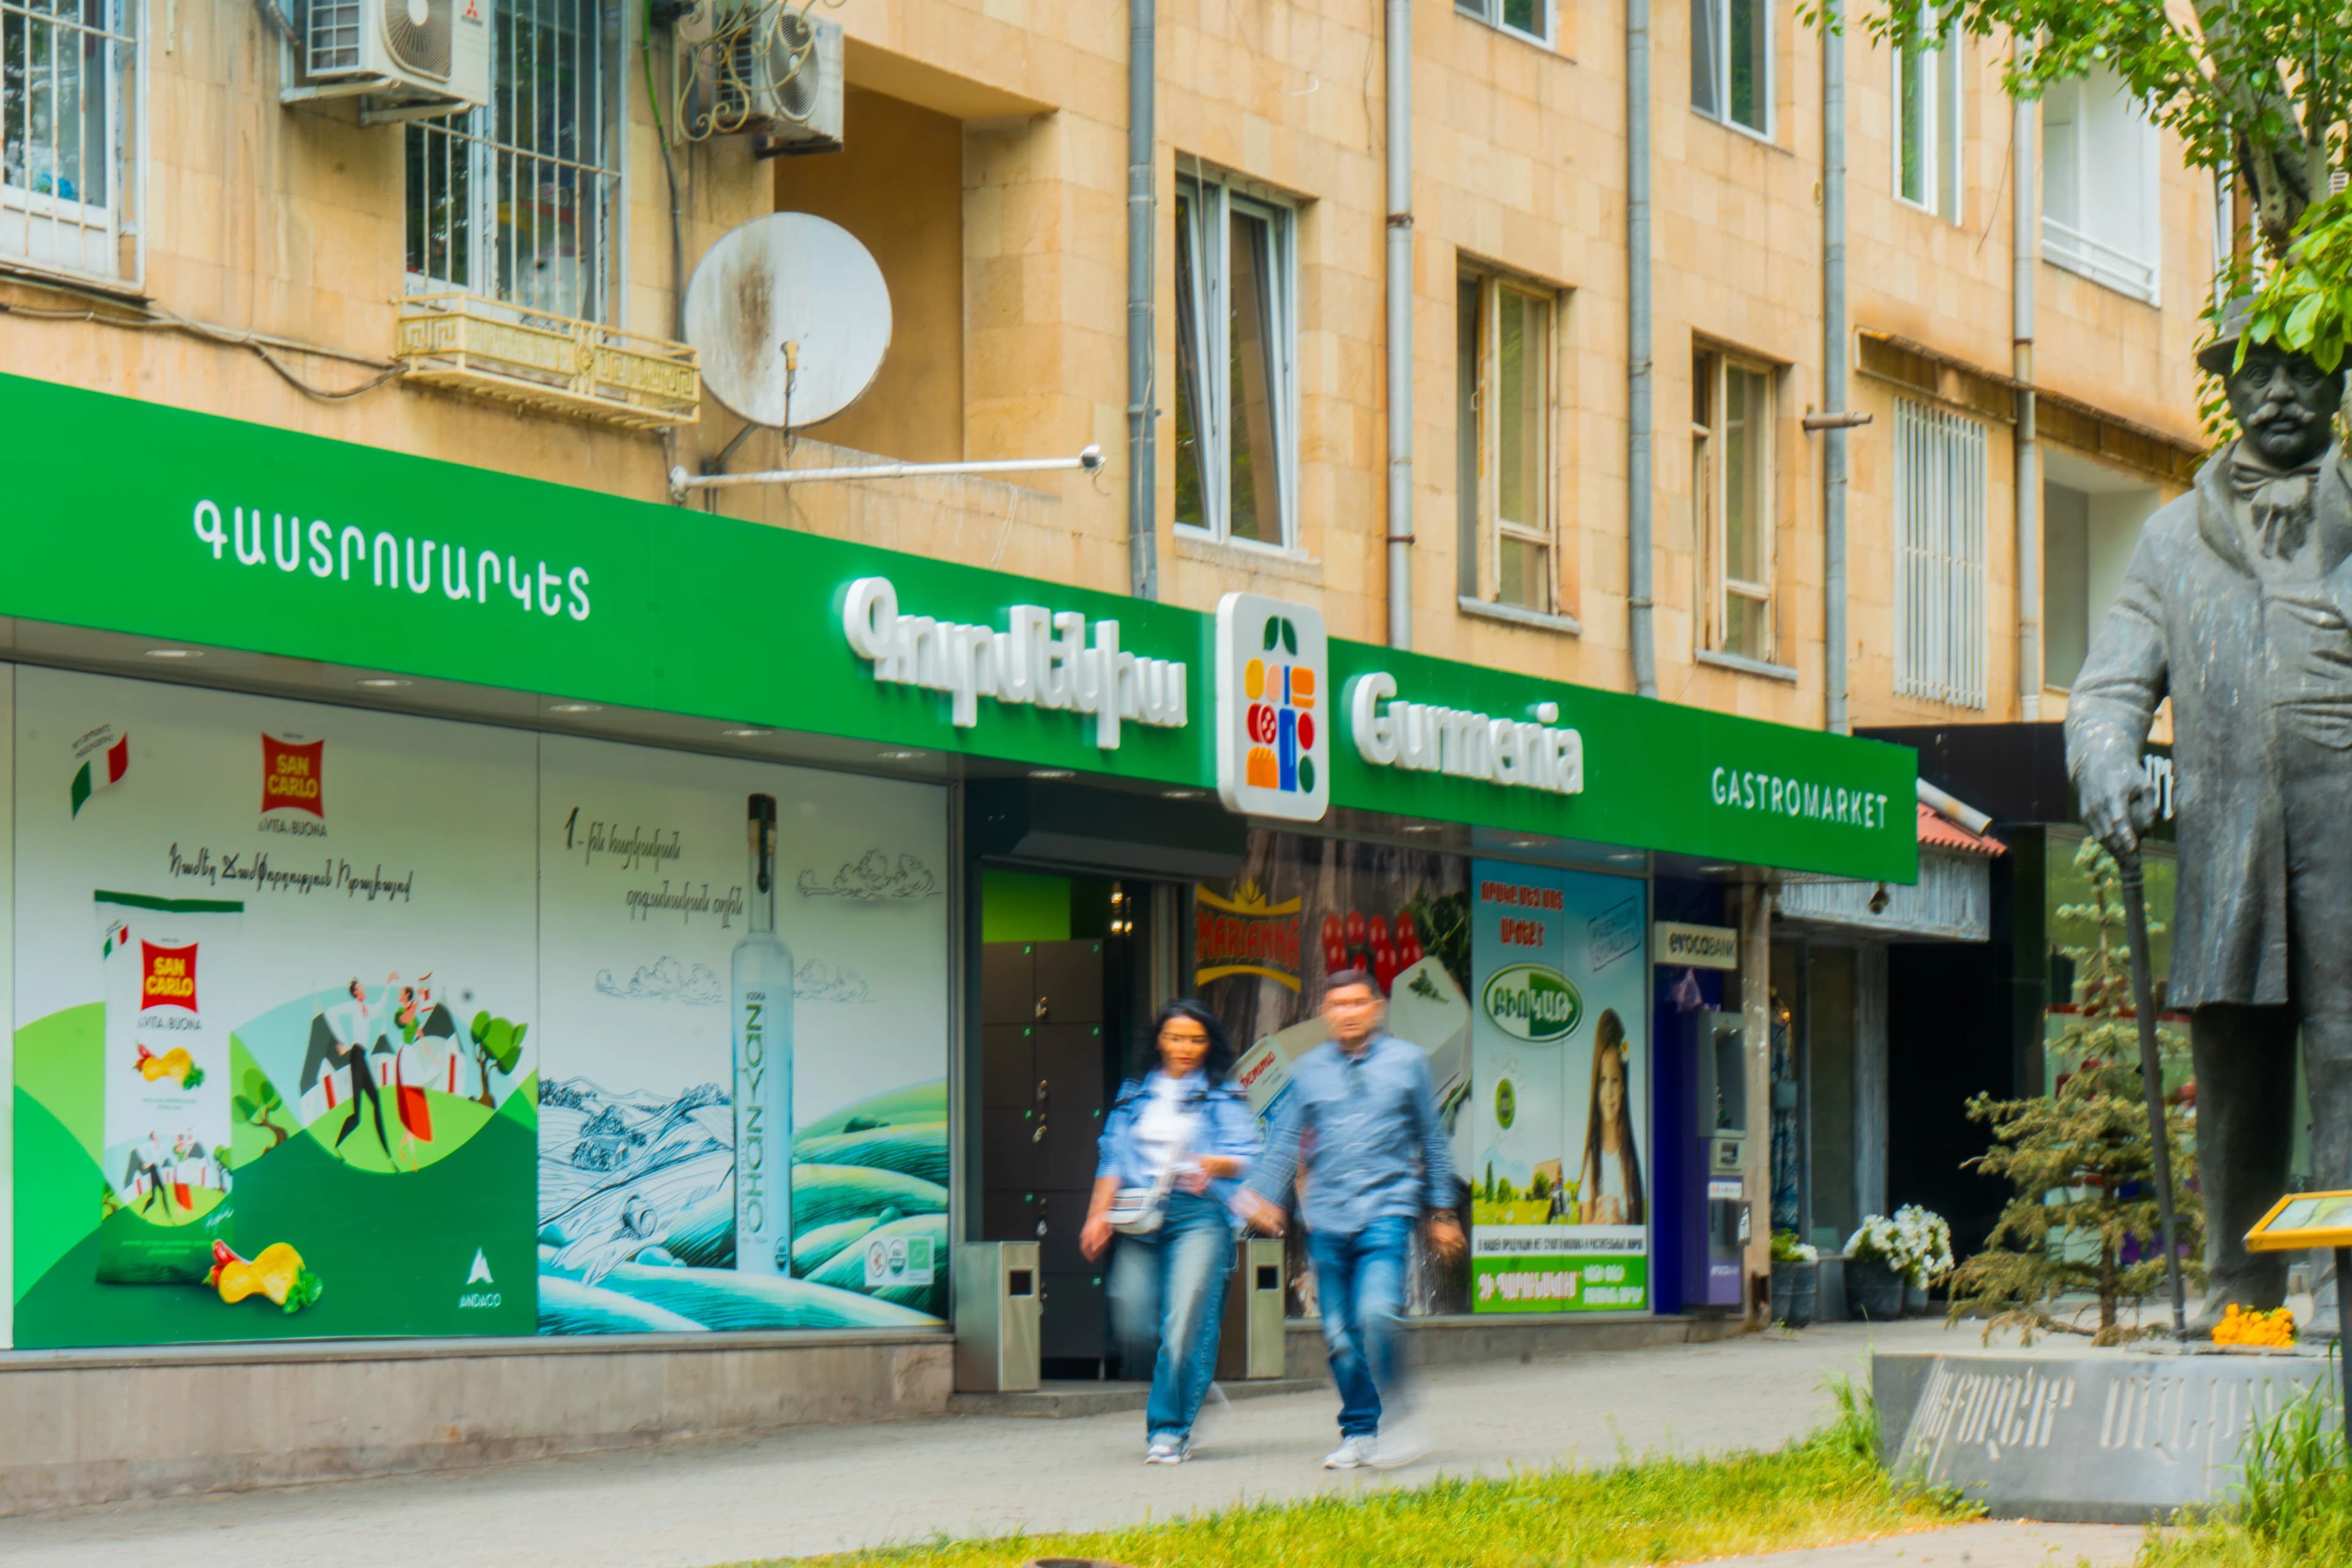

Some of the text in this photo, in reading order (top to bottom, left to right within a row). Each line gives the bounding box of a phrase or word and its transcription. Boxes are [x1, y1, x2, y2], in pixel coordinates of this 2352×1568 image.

[194, 499, 590, 621] ԳԱՍՏՐՈՄԱՐԿԵՏ
[843, 576, 1188, 750] Գուրմենիա
[1352, 671, 1584, 796] Gurmenia
[276, 754, 309, 775] SAN
[268, 776, 318, 799] CARLO
[1712, 766, 1888, 829] GASTROMARKET
[1197, 910, 1300, 971] MARIANNA
[146, 976, 194, 998] CARLO
[154, 957, 186, 976] SAN
[459, 1293, 501, 1308] ANDACO
